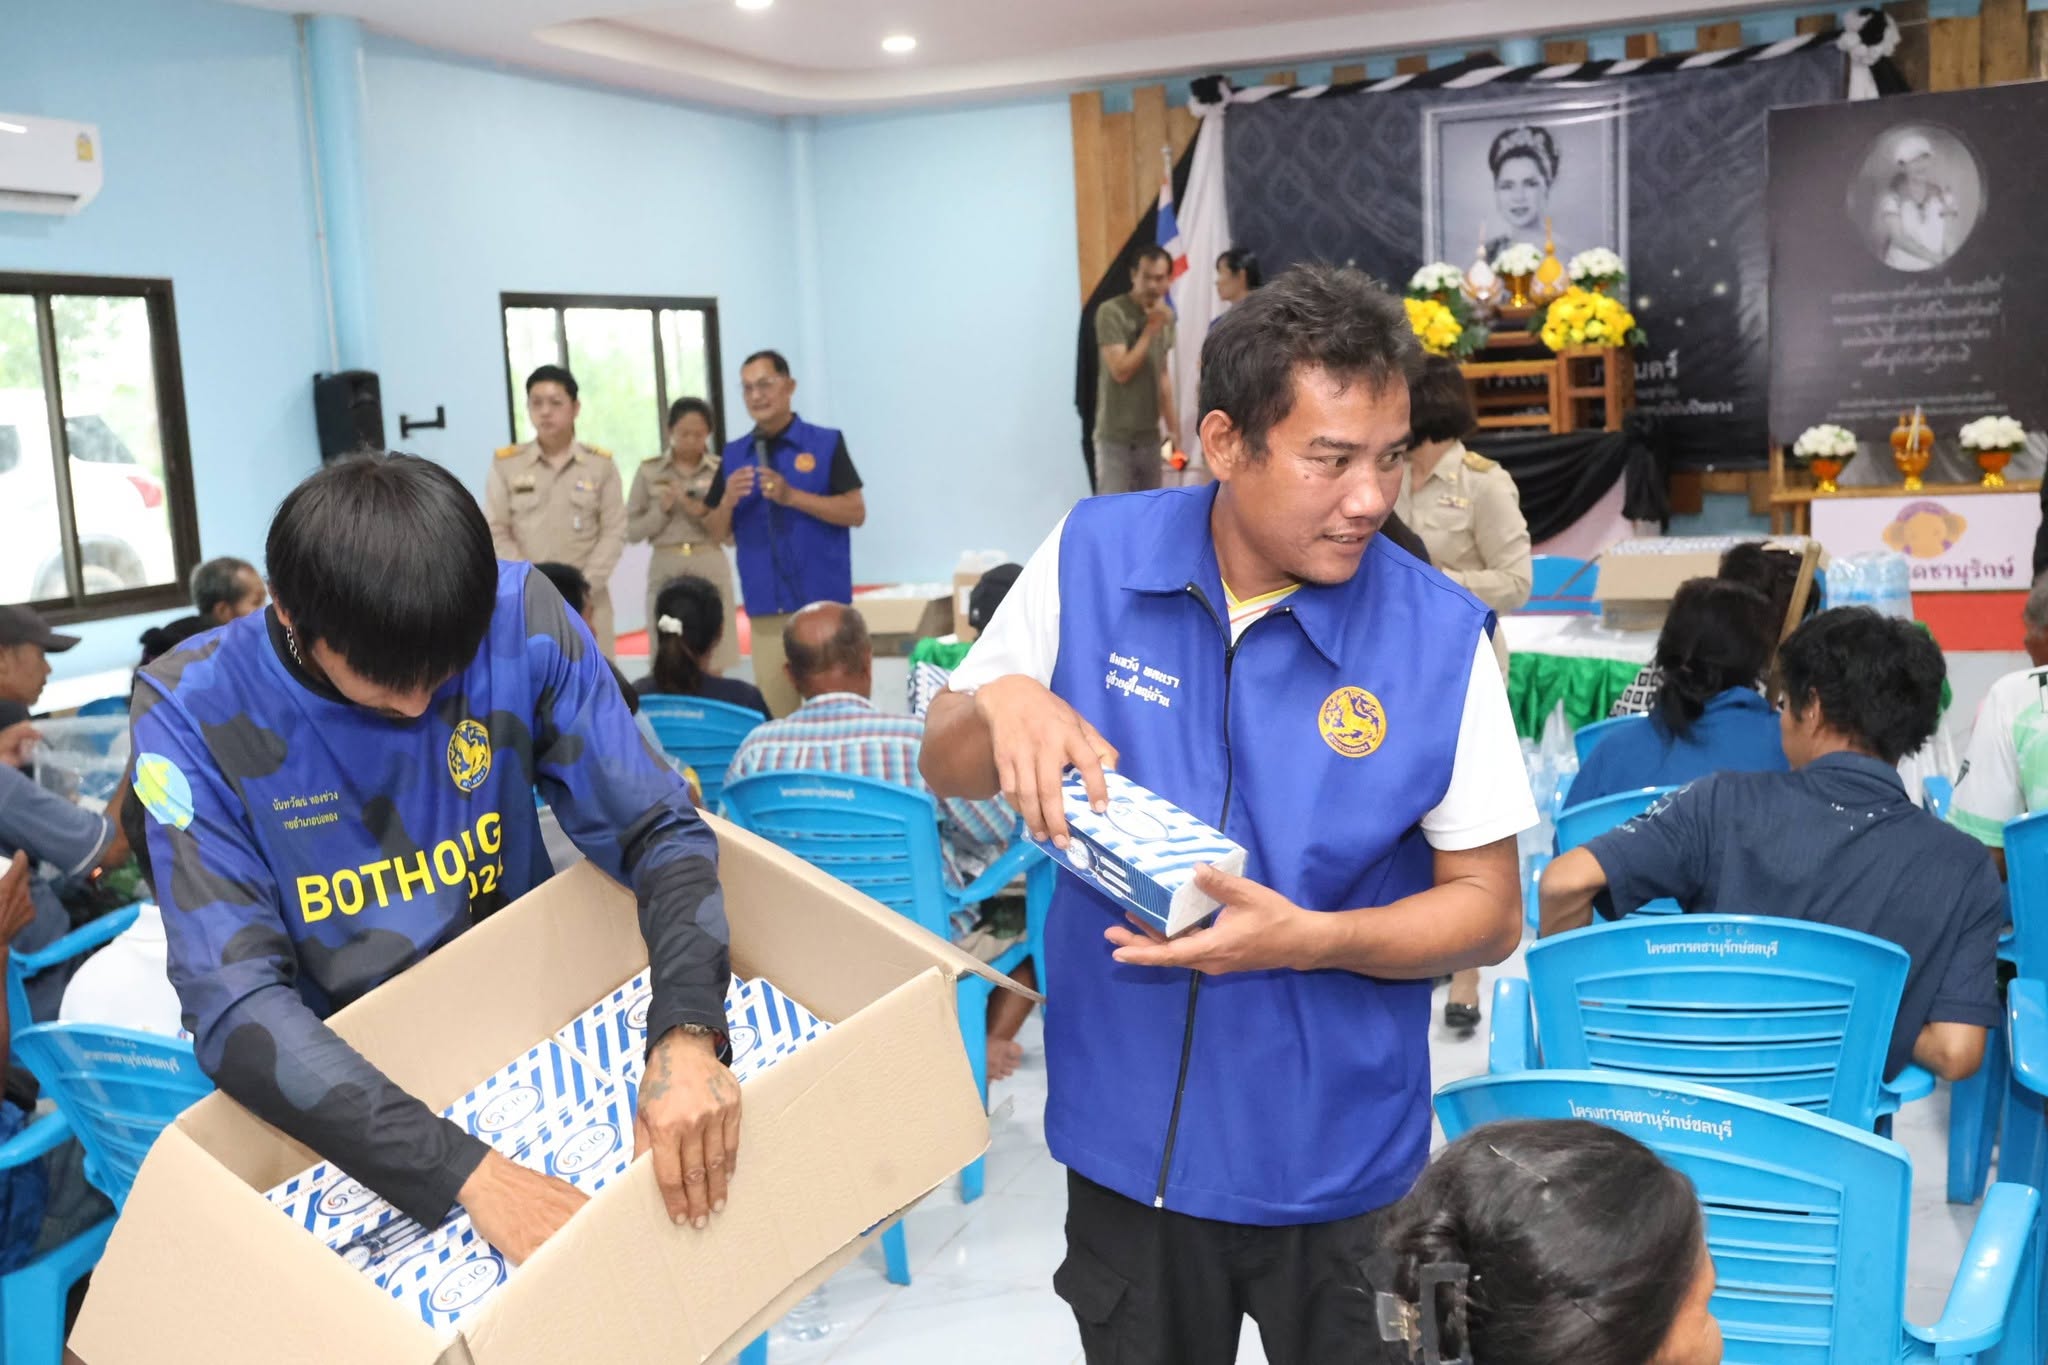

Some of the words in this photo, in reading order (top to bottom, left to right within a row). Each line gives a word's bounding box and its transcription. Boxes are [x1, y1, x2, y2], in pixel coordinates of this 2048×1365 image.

[1567, 1099, 1733, 1141] โครงการคชานุรักษ์ชลบุรี
[579, 1130, 606, 1152] CIG
[457, 1263, 488, 1289] CIG
